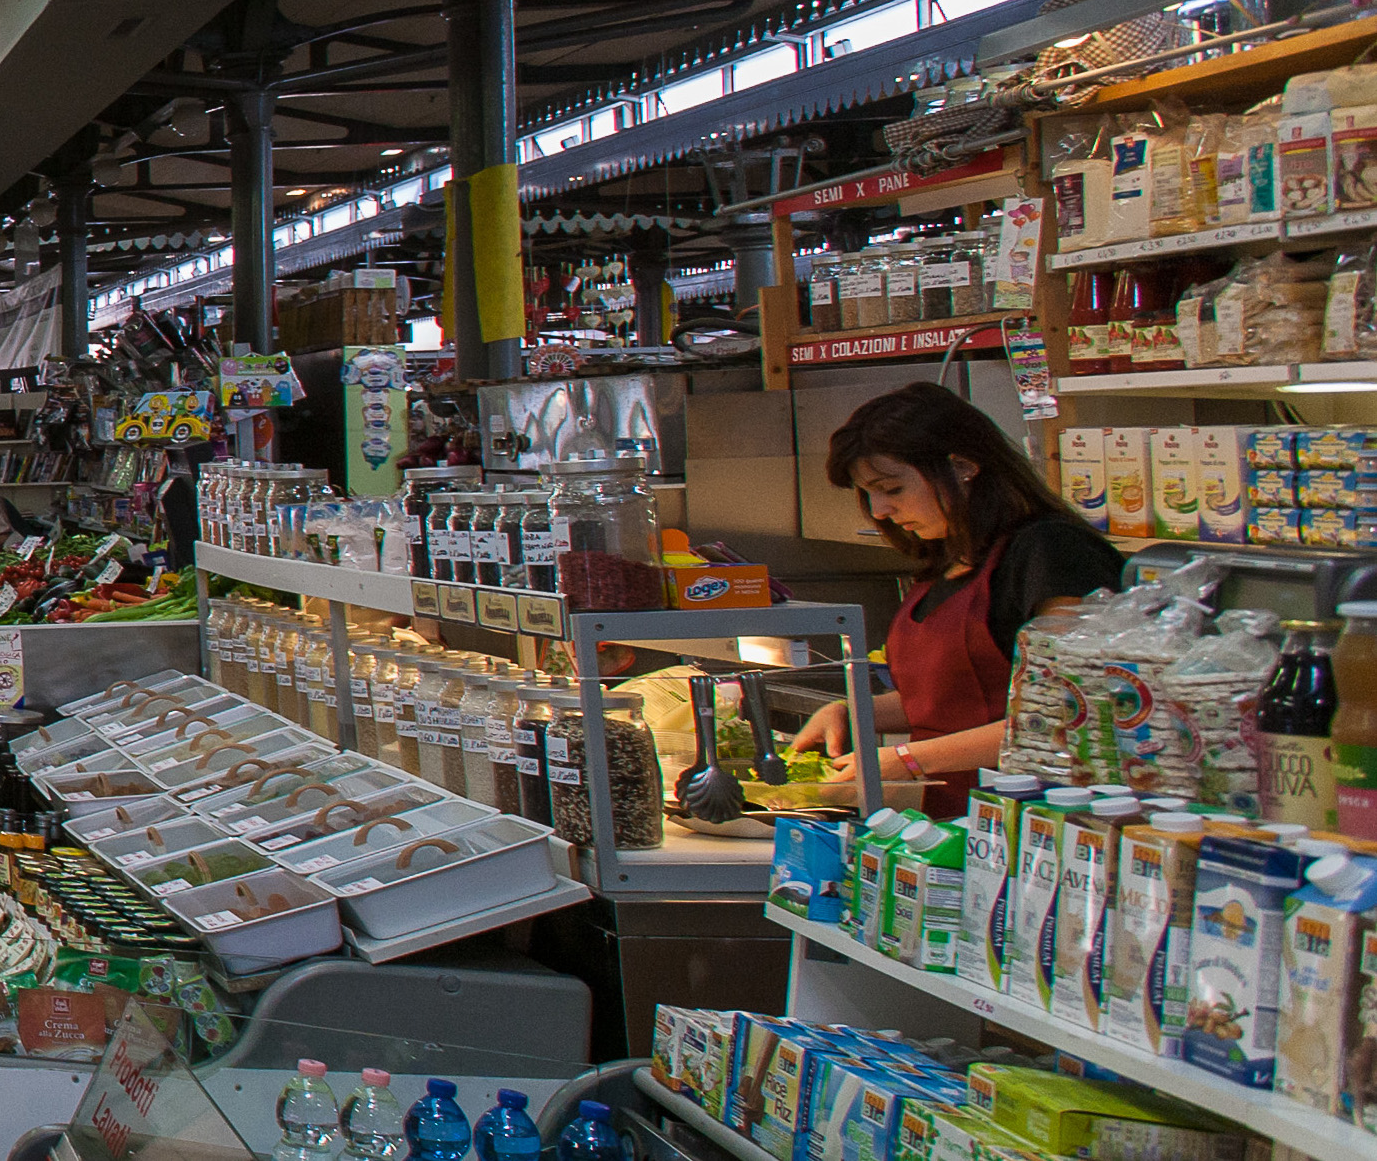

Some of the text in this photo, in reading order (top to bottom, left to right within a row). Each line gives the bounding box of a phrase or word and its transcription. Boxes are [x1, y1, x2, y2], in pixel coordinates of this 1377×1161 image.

[814, 172, 910, 205] SEMI X PANE
[792, 345, 814, 362] SEMI
[819, 343, 827, 360] X
[831, 336, 897, 358] COLAZIONI
[900, 335, 908, 351] E
[686, 579, 727, 598] Logex
[966, 836, 1007, 866] SOYA
[1024, 851, 1055, 883] RICE
[44, 1019, 80, 1030] Crema
[54, 1029, 85, 1040] Zucca
[109, 1040, 160, 1119] Prodotti
[764, 1071, 788, 1099] Rice
[773, 1097, 793, 1123] Riz
[90, 1091, 131, 1158] Lavati
